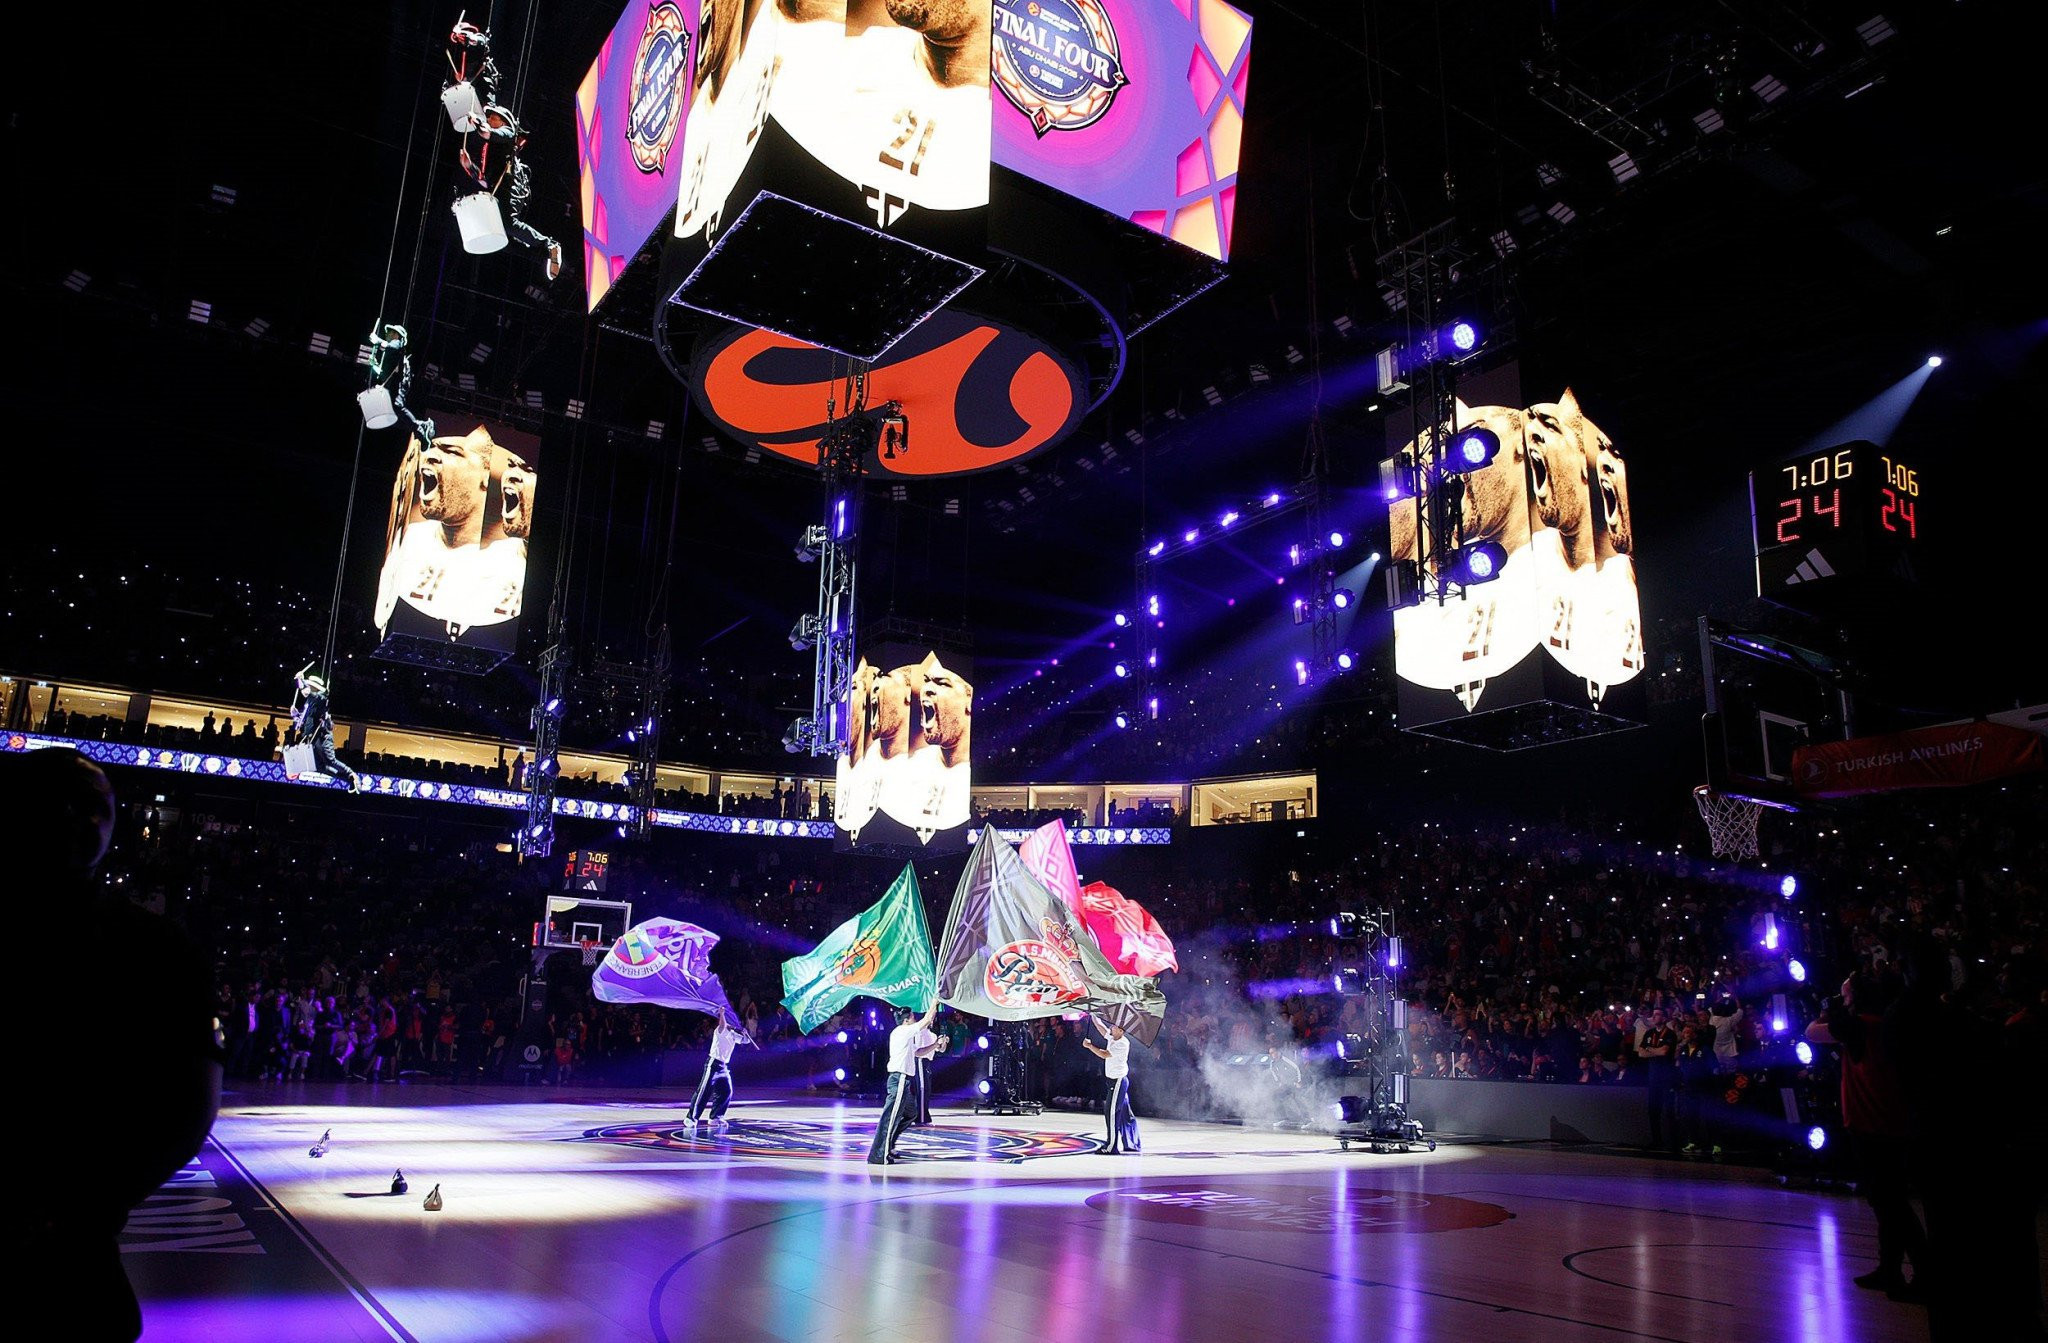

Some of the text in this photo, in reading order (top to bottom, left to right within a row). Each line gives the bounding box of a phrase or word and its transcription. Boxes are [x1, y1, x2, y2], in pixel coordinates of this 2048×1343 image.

[993, 4, 1050, 53] FINAL
[1053, 35, 1110, 83] FOUR
[1017, 45, 1035, 58] ABU
[879, 108, 936, 176] 21
[1782, 449, 1853, 491] 7:06
[1881, 456, 1919, 497] 7:06
[1776, 488, 1840, 543] 24
[1881, 488, 1916, 539] 24
[1462, 600, 1498, 662] 21
[1550, 597, 1573, 650] 21
[1835, 736, 1984, 774] TURKISH AIRLINES
[474, 789, 500, 802] FINAL
[582, 862, 603, 877] 24
